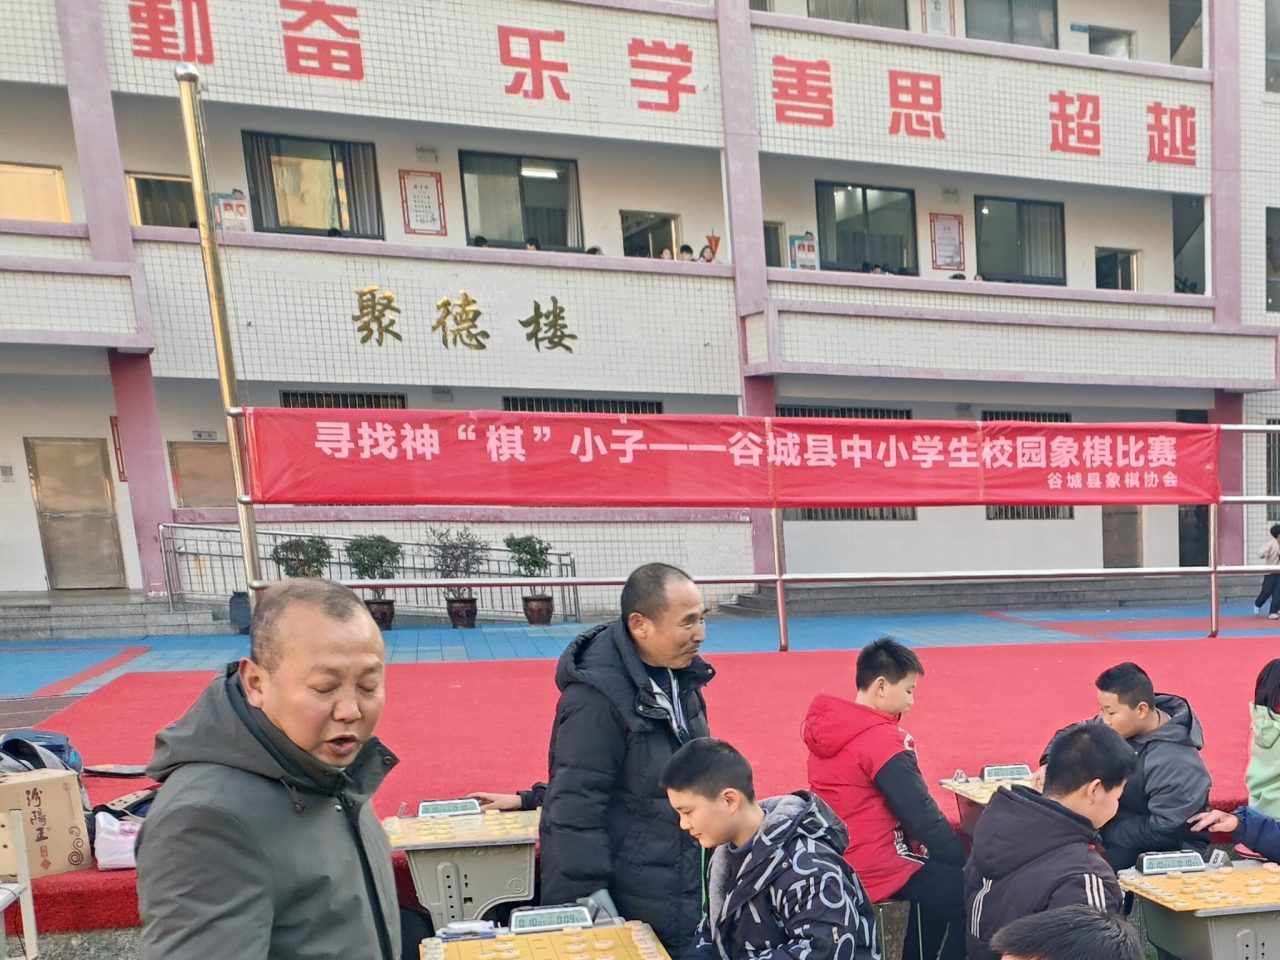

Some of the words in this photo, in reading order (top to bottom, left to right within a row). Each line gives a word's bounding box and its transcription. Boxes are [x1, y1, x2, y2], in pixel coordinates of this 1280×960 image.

[498, 25, 697, 113] 乐学
[771, 55, 946, 140] 善思
[1049, 90, 1197, 166] 超越
[351, 284, 578, 354] 聚德楼
[1046, 471, 1179, 490] 谷城县象棋协会
